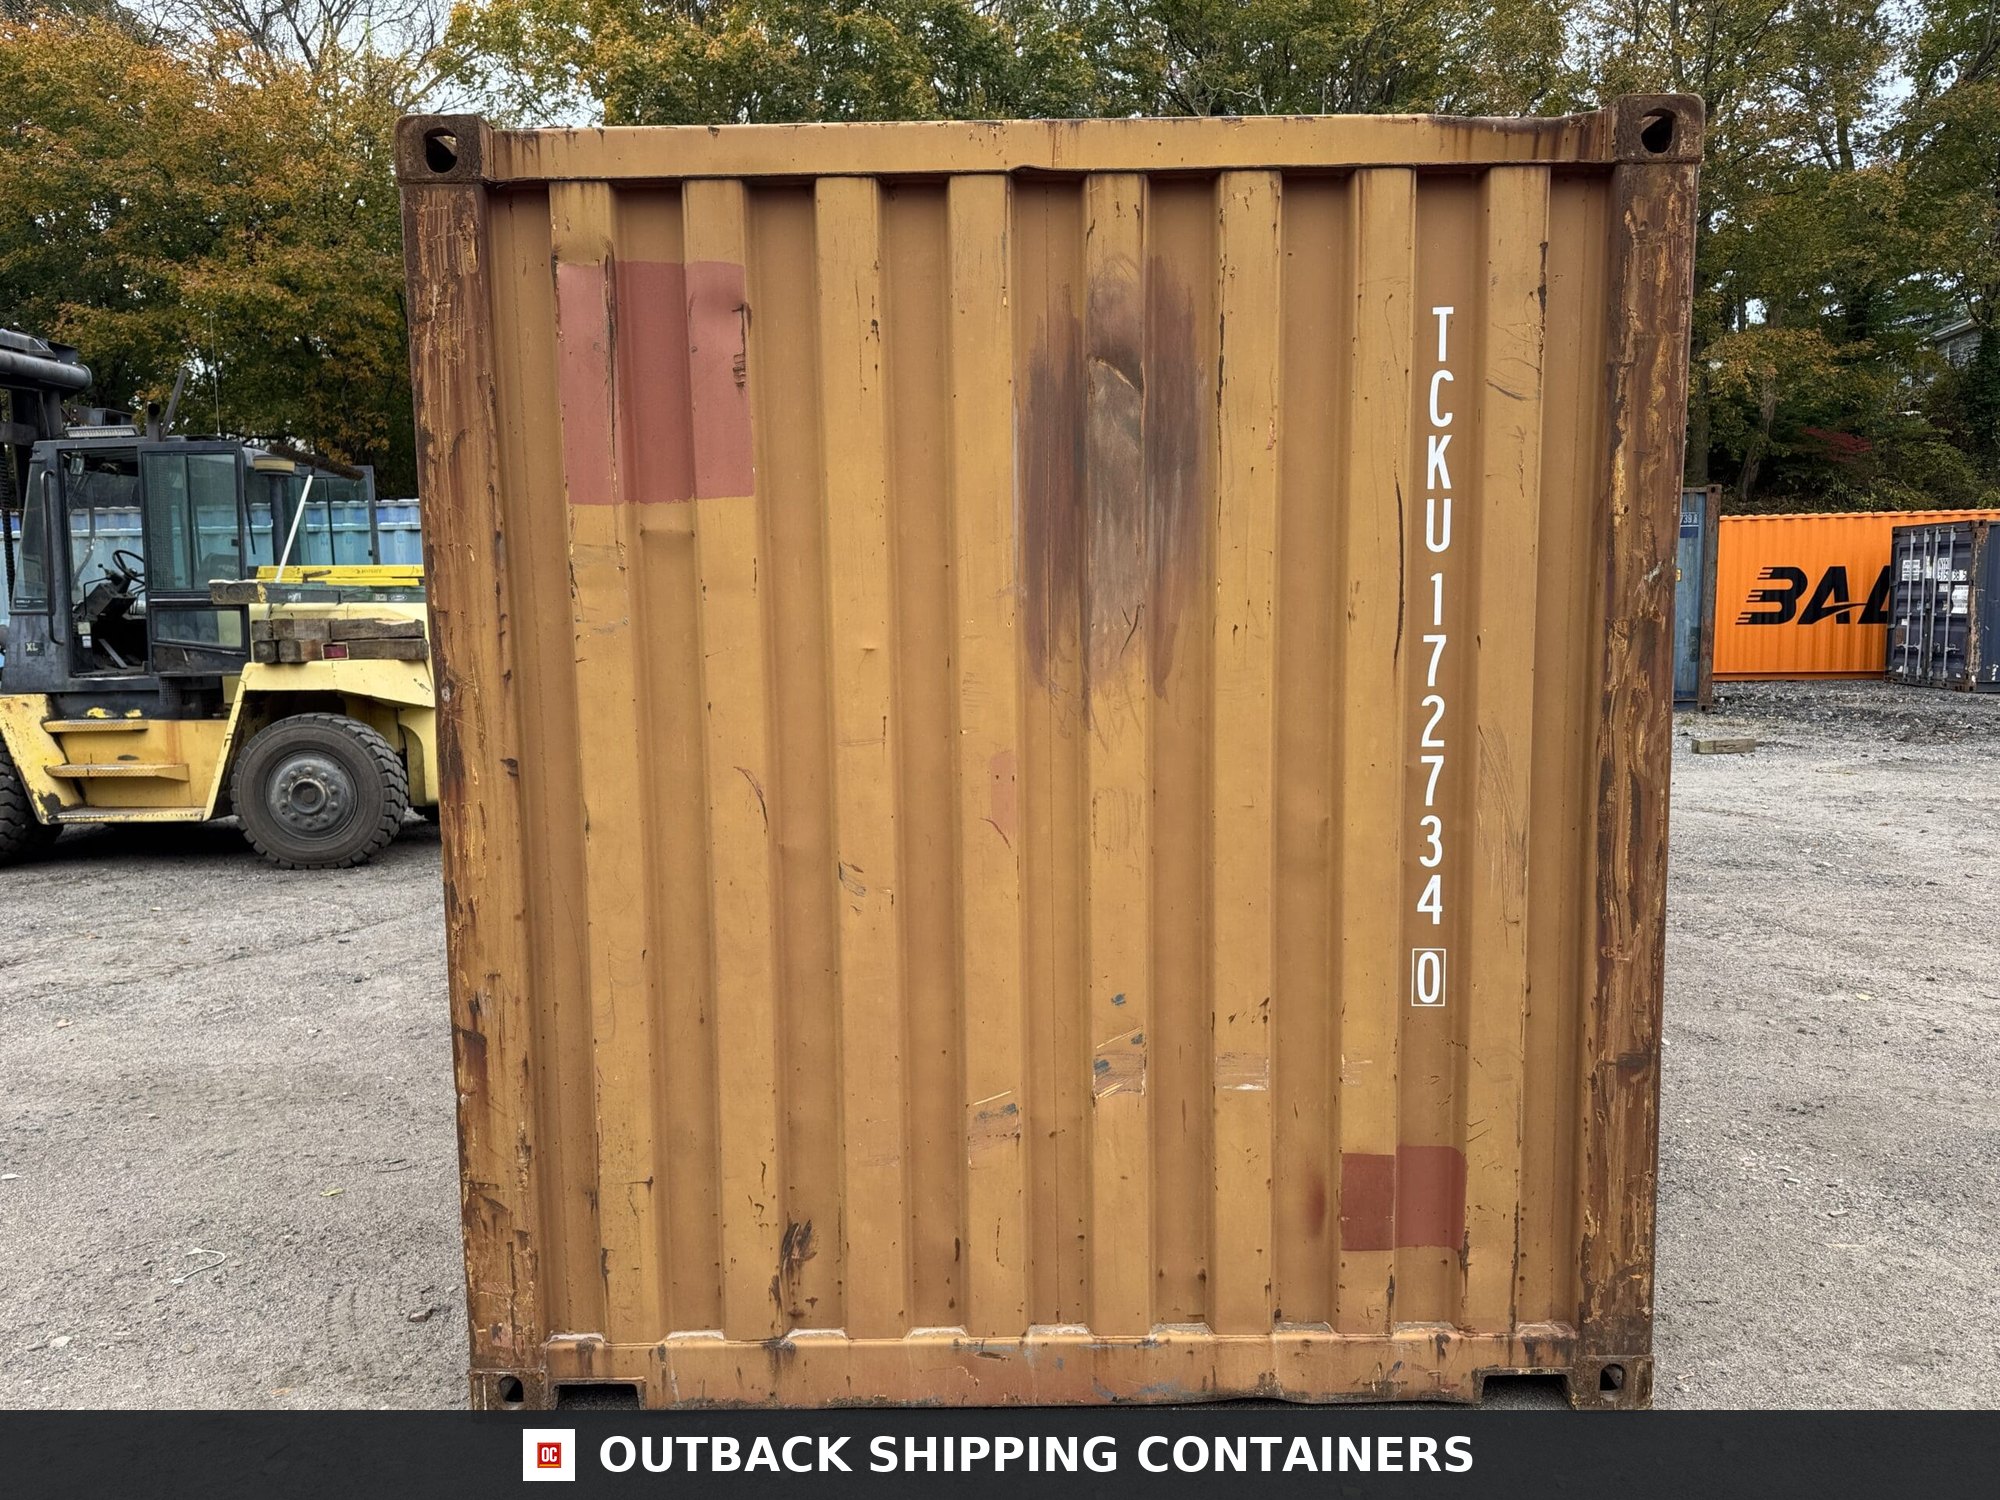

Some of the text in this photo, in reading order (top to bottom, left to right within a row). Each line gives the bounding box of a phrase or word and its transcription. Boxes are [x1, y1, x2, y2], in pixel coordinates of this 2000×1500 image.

[1416, 306, 1455, 1005] TCKU 172734 0
